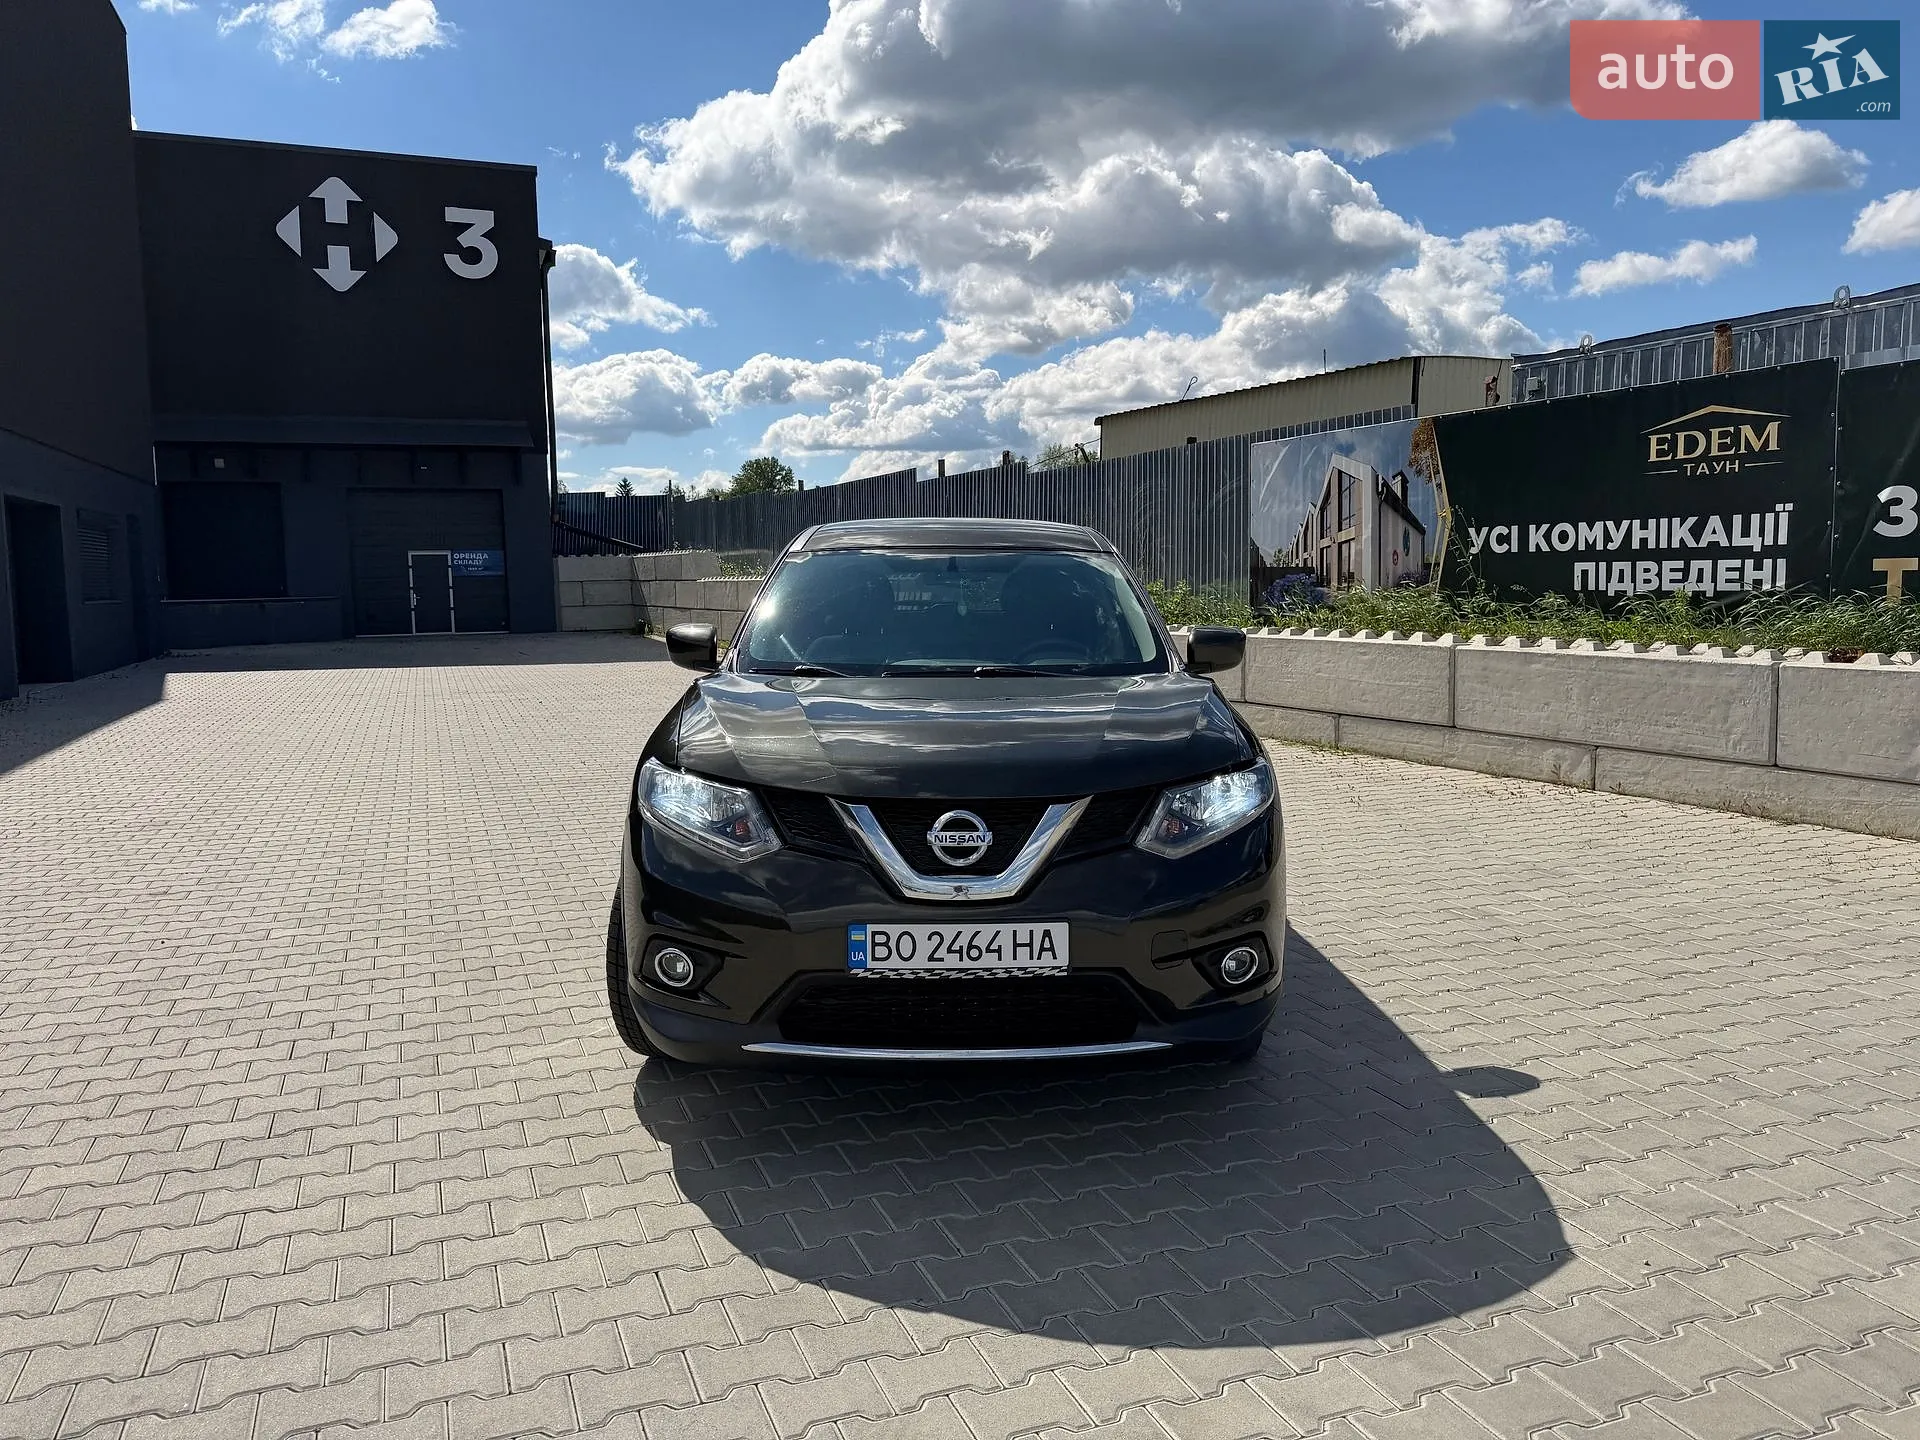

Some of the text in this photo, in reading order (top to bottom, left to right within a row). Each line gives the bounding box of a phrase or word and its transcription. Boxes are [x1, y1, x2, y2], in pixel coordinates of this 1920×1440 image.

[443, 206, 499, 280] 3
[1647, 420, 1782, 462] EDEM
[1682, 459, 1741, 476] ТАУН
[1467, 502, 1794, 554] УСІ КОМУНІКАЦІЇ
[1573, 558, 1787, 598] ПІДВЕДЕНІ
[933, 833, 987, 845] NISSAN
[851, 952, 866, 962] UA
[870, 928, 1058, 963] BO 2464 HA
